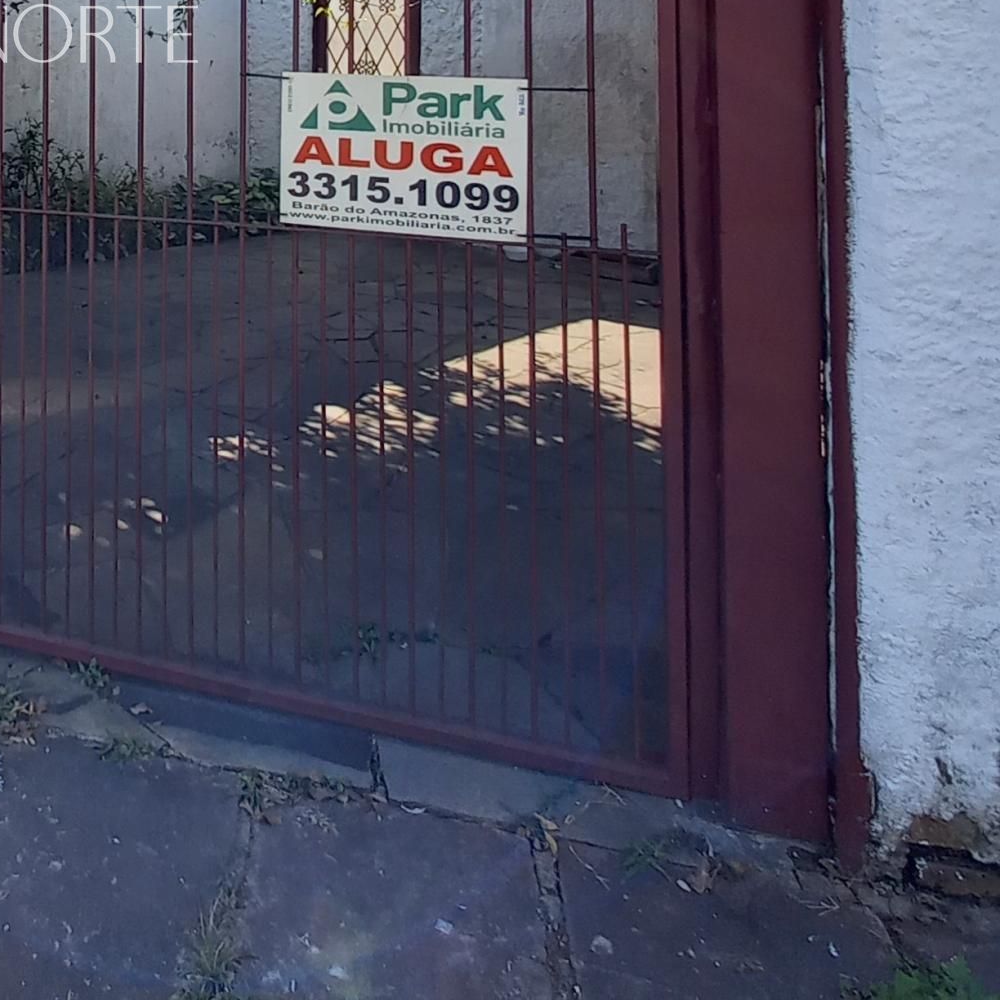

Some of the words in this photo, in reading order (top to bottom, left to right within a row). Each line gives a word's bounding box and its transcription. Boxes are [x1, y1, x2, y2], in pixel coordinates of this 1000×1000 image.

[382, 81, 505, 122] Park
[382, 119, 505, 139] Imobiliária
[293, 135, 514, 178] ALUGA
[287, 171, 520, 213] 3315.1099
[289, 211, 517, 236] www.parkimobiliaria.com.br
[292, 201, 340, 213] Barão
[345, 203, 366, 215] do
[370, 206, 465, 224] Amazonas,
[472, 214, 513, 226] 1837
